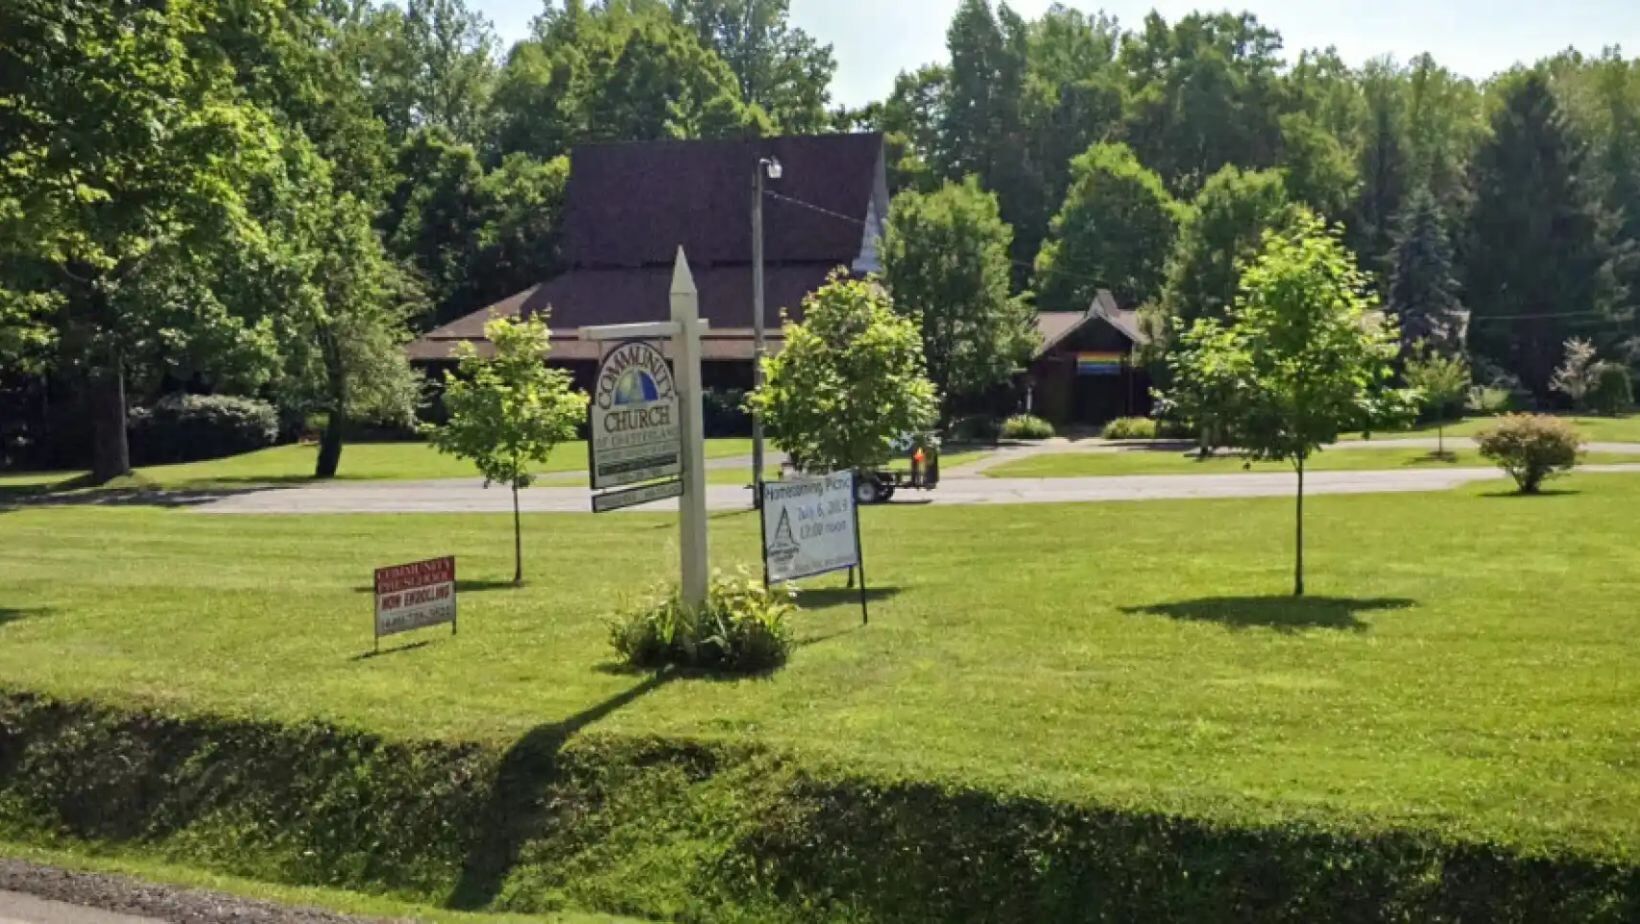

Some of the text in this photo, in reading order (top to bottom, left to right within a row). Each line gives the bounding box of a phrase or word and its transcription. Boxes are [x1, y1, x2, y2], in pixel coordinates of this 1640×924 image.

[598, 346, 675, 410] COMMUNITY
[603, 404, 672, 432] CHURCH
[765, 482, 823, 501] Homecoming
